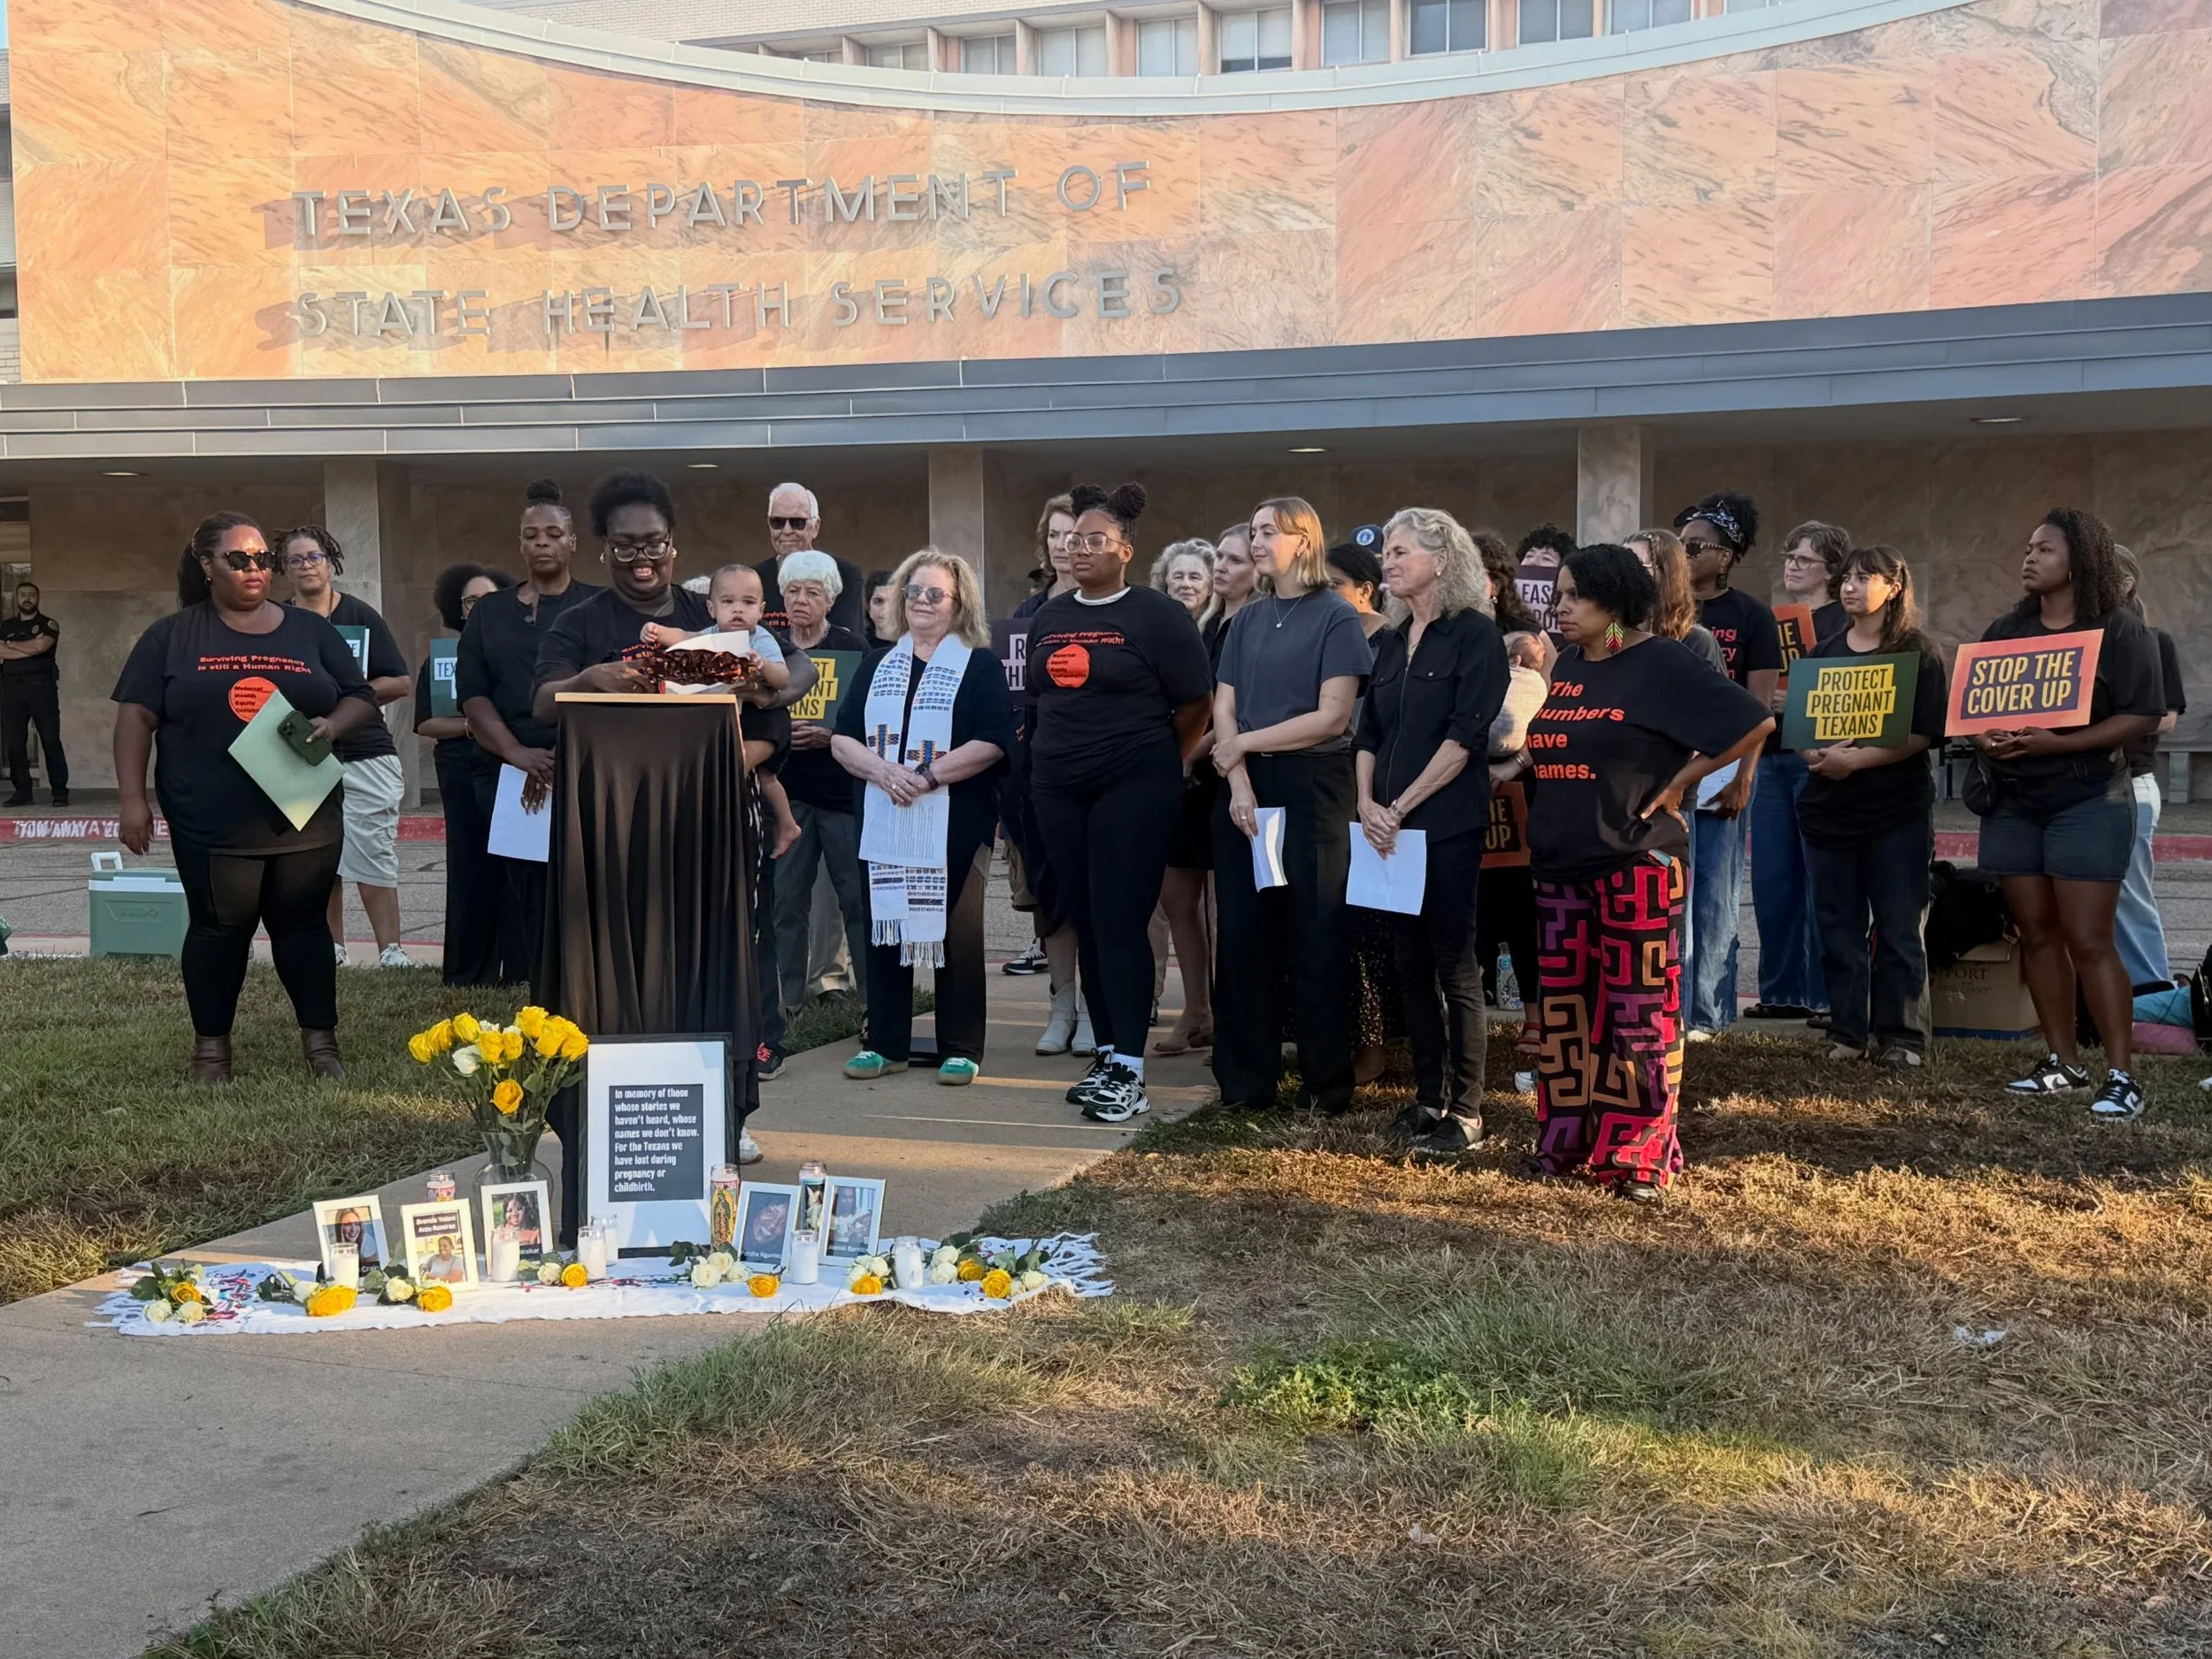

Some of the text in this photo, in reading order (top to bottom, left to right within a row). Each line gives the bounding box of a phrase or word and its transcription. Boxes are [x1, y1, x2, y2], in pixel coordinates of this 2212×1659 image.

[292, 160, 1150, 236] TEXAS DEPARTMENT OF
[297, 267, 1180, 337] STATE HEALTH SERVICES
[251, 655, 305, 666] Pregnancy
[284, 664, 311, 673] Right
[437, 661, 457, 679] TEX
[1972, 651, 2076, 685] STOP THE
[1821, 669, 1888, 692] PROTECT
[1550, 681, 1584, 697] The
[1810, 691, 1893, 715] PREGNANT
[1967, 680, 2072, 715] COVER UP
[1821, 714, 1878, 736] TEXANS
[615, 1087, 688, 1100] In memory of those
[615, 1102, 680, 1112] whose stories we
[615, 1114, 696, 1125] haven't heard, whose
[615, 1130, 640, 1139] names
[655, 1127, 675, 1138] don't
[677, 1127, 699, 1137] know.
[615, 1142, 627, 1152] For
[629, 1141, 641, 1152] the
[643, 1141, 670, 1151] Texans
[615, 1154, 676, 1166] have lost during
[614, 1170, 656, 1181] pregnancy
[614, 1182, 656, 1193] childbirth.
